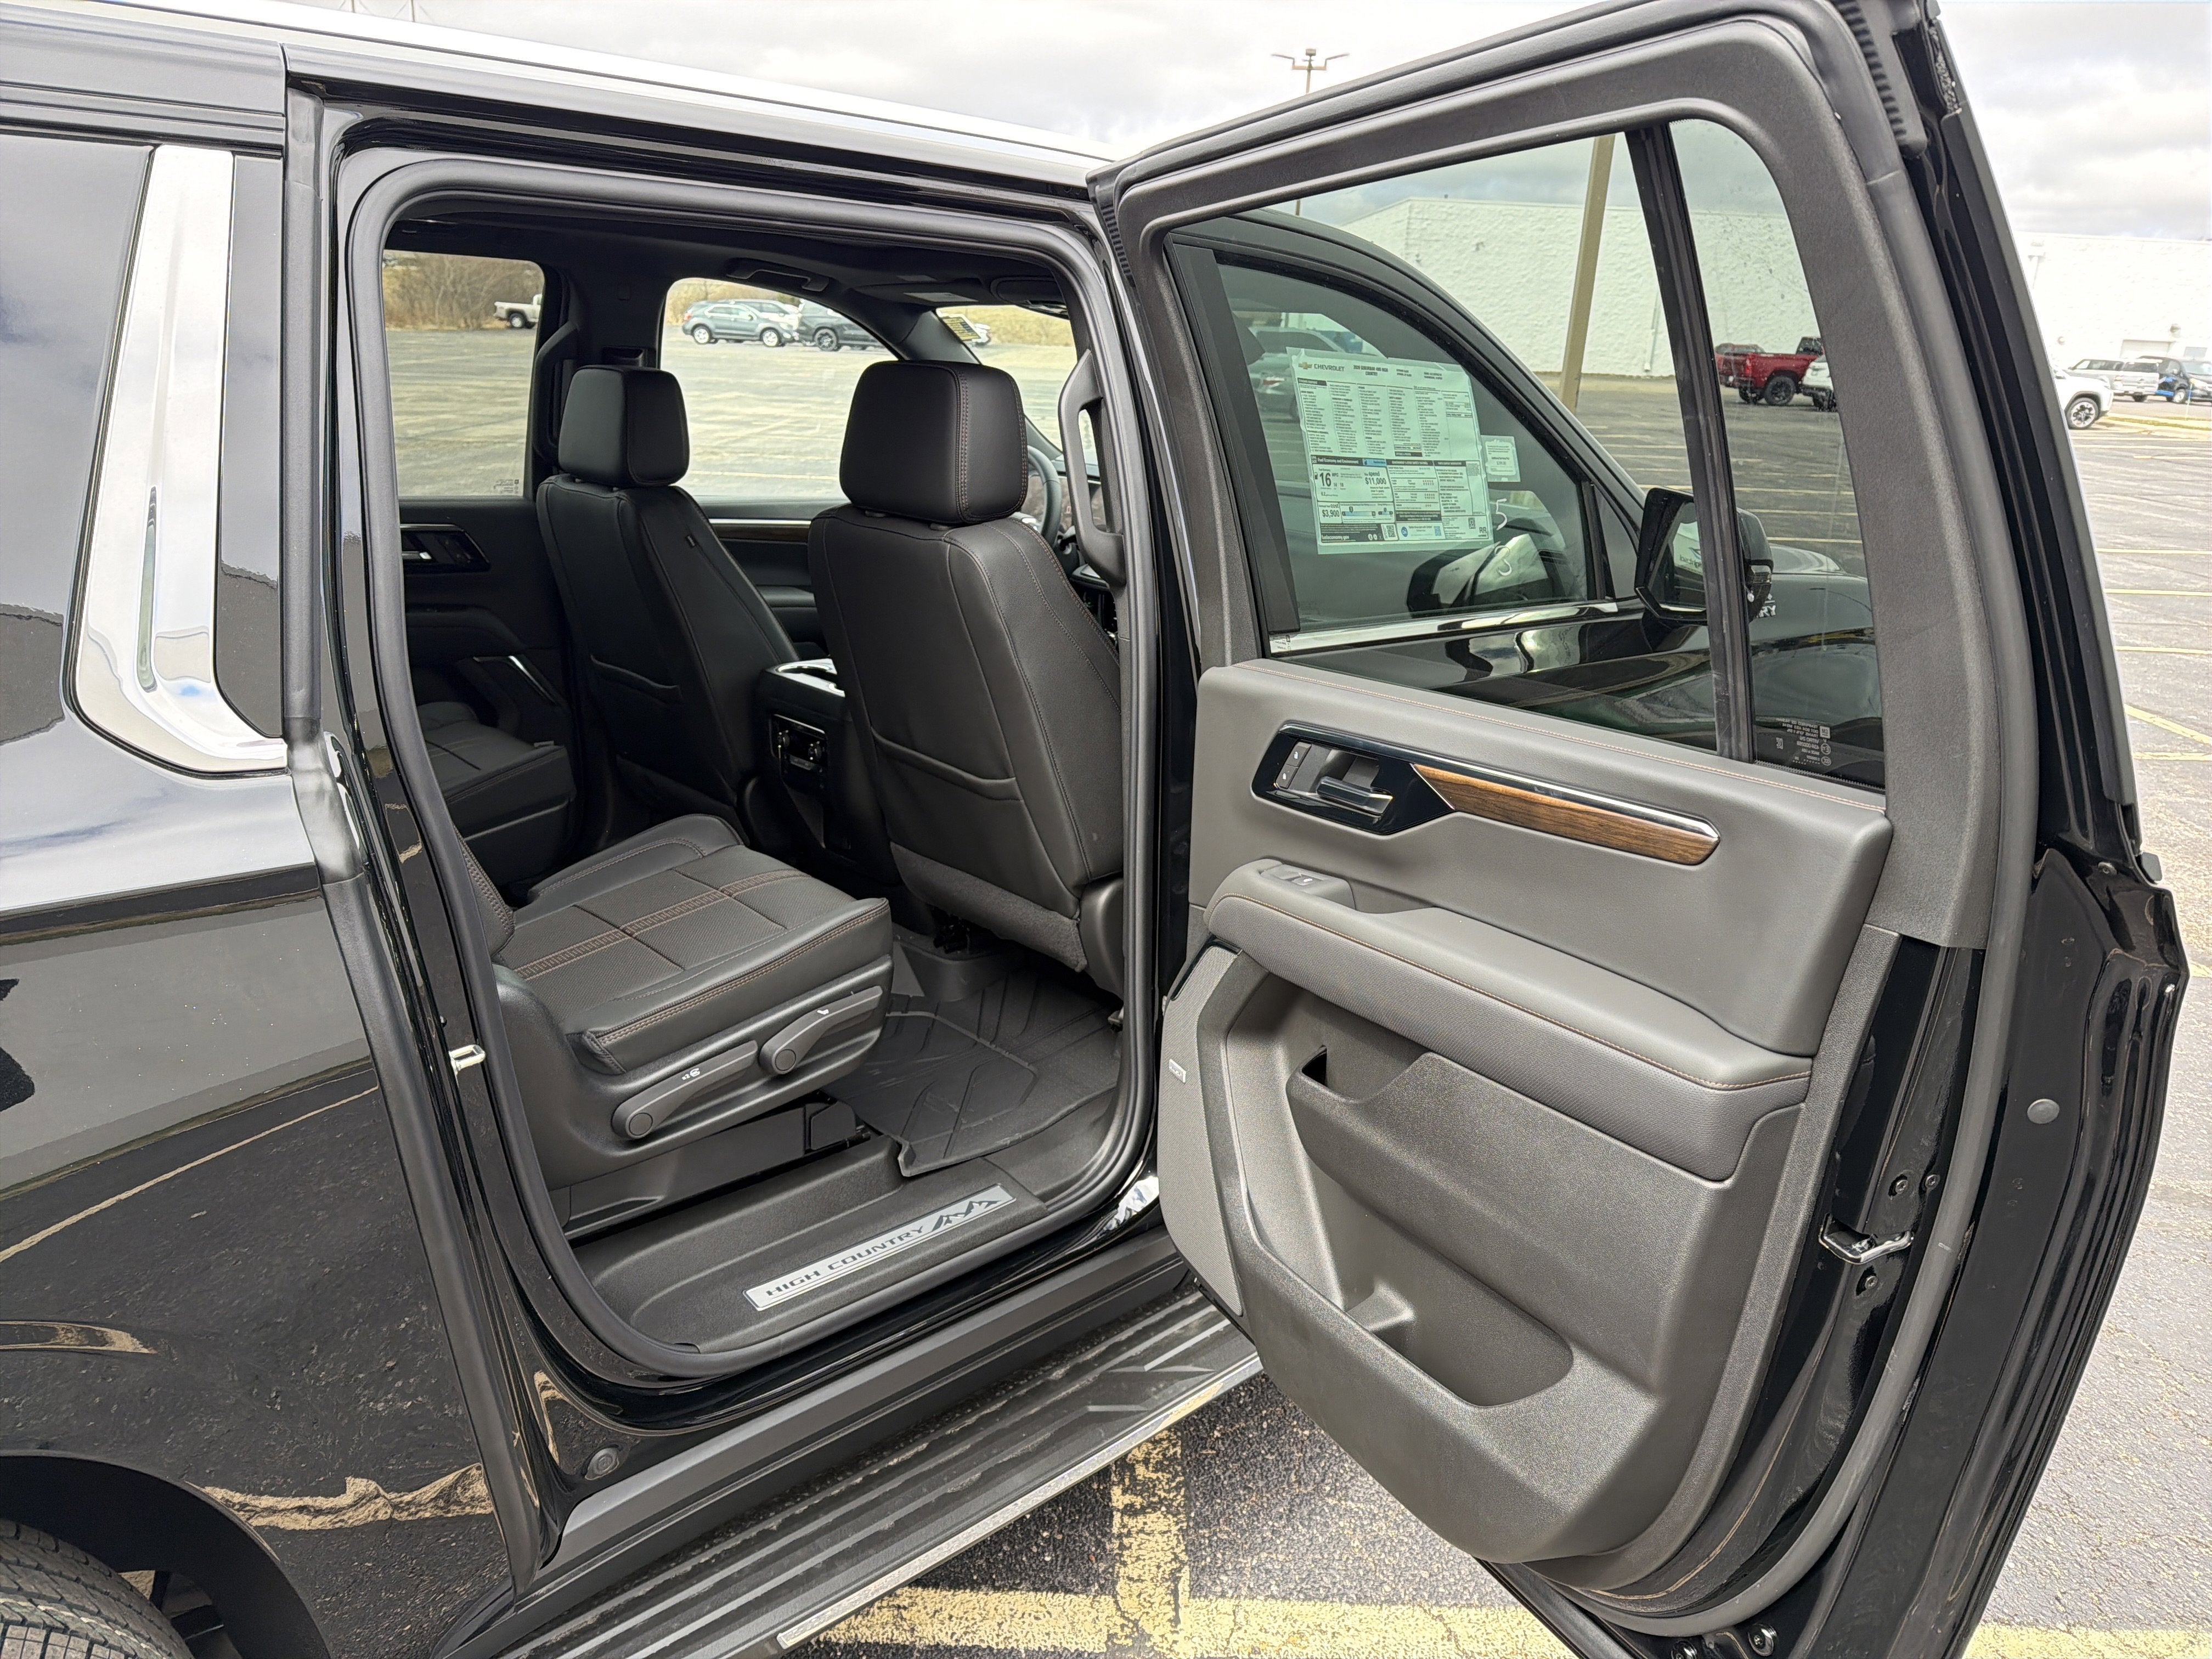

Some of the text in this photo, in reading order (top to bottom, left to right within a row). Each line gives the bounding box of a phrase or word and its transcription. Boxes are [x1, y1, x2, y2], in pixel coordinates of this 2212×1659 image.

[1319, 472, 1331, 487] 16
[1364, 477, 1386, 486] $11,000
[1322, 510, 1340, 518] $3,900
[766, 1225, 924, 1296] HIGH COUNTRY
